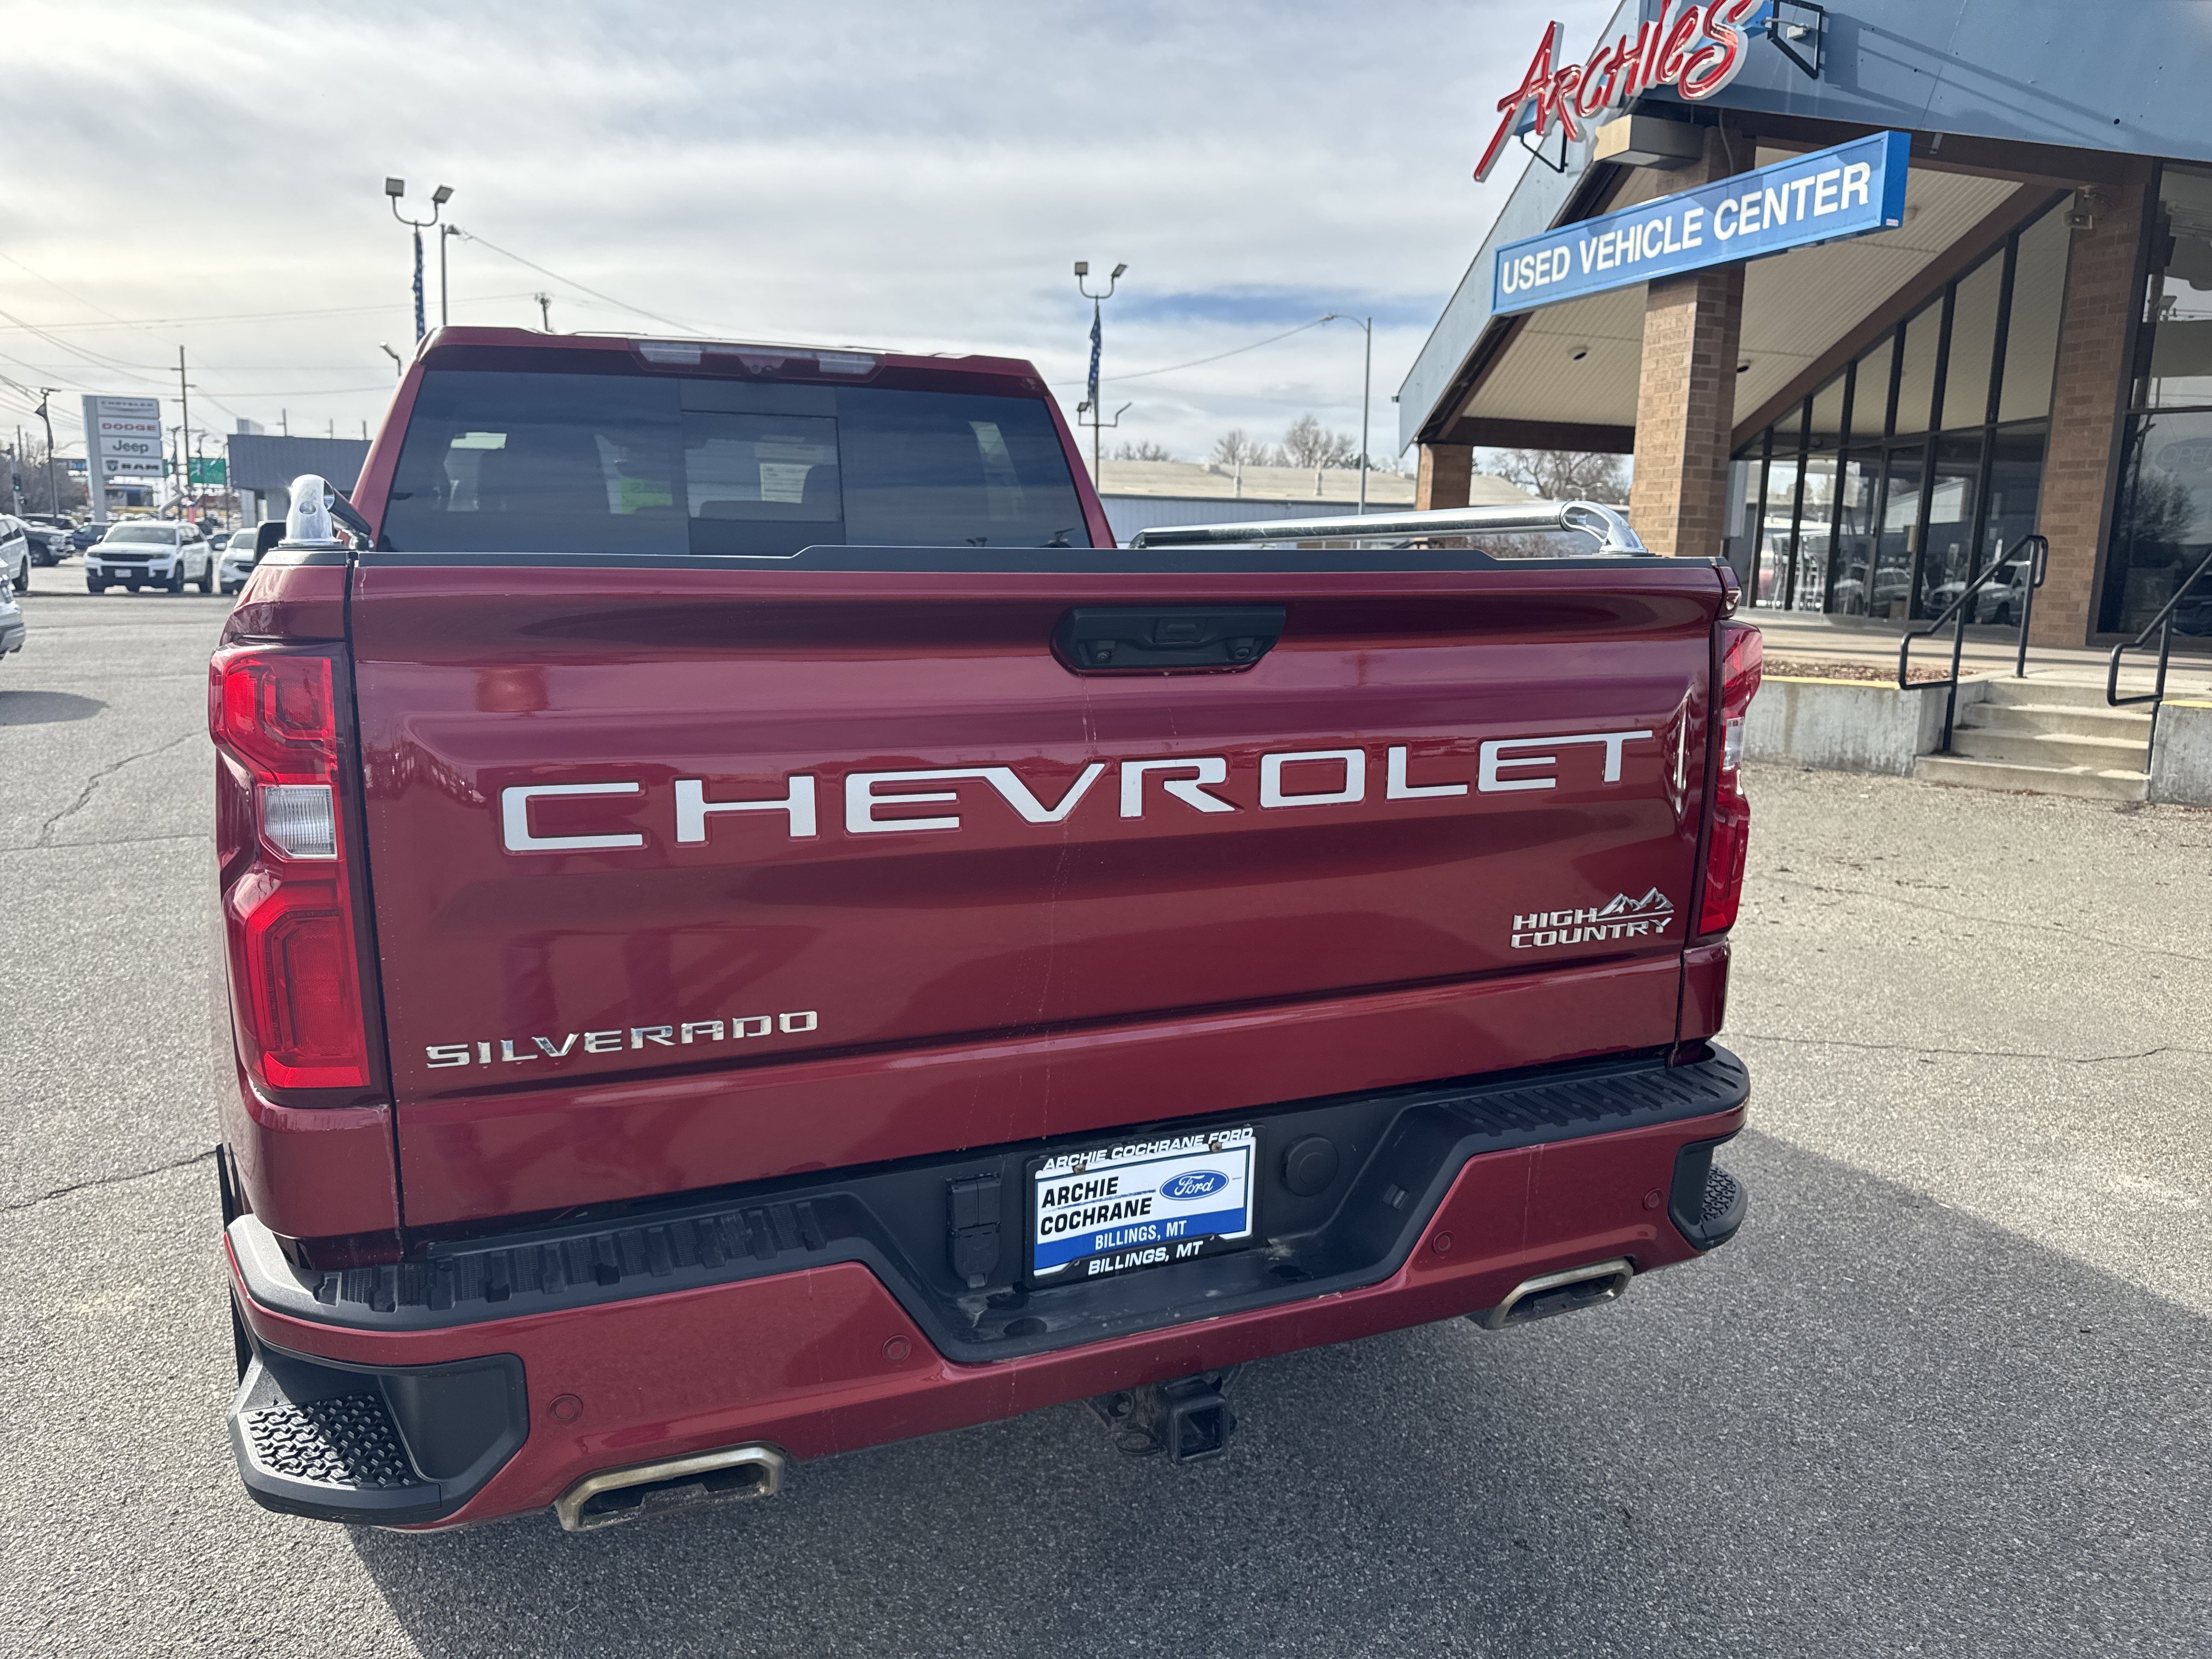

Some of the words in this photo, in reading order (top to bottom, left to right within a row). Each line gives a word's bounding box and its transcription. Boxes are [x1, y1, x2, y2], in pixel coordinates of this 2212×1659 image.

[1502, 245, 1571, 294] USED
[1579, 207, 1704, 274] VEHICLE
[1713, 162, 1871, 240] CENTER
[102, 422, 156, 431] DODGE
[112, 439, 149, 454] Jeep
[501, 730, 1653, 852] CHEVROLET
[1511, 917, 1672, 949] COUNTRY
[1513, 907, 1598, 930] HIGH
[426, 1011, 817, 1069] SILVERADO
[1042, 1149, 1107, 1172] ARCHIE
[1111, 1135, 1204, 1160] COCHRANE
[1208, 1127, 1253, 1144] FORD
[1042, 1176, 1119, 1209] ARCHIE
[1174, 1175, 1215, 1196] Ford
[1041, 1197, 1152, 1235] COCHRANE
[1095, 1226, 1161, 1251] BILLINGS,
[1166, 1220, 1187, 1238] MT
[1088, 1246, 1170, 1276] BILLINGS,
[1176, 1240, 1204, 1259] MT
